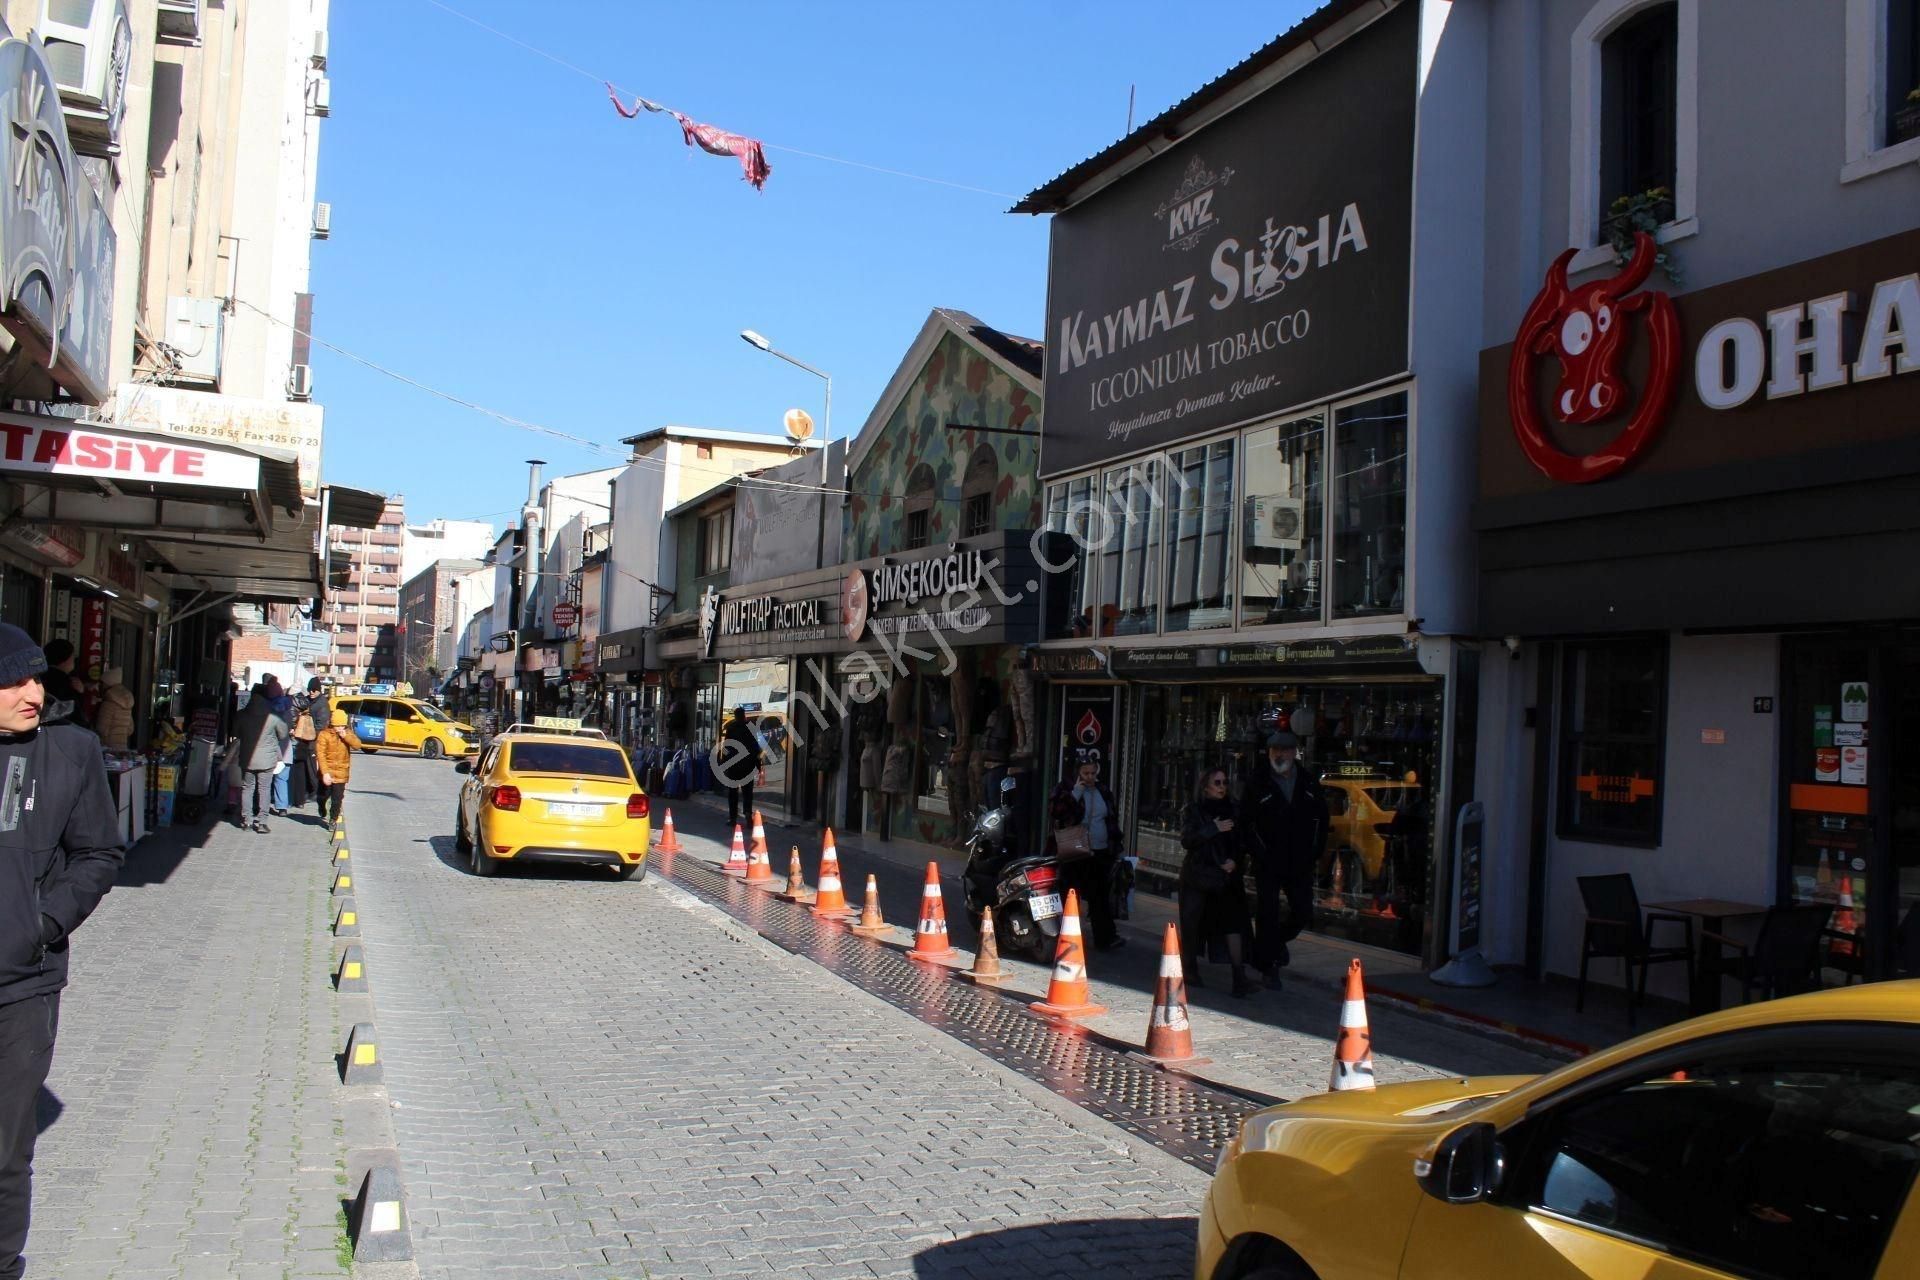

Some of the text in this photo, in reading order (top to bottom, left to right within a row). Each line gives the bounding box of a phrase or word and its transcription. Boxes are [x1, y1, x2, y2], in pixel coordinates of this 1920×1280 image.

[1059, 276, 1196, 374] KAYMAZ
[1089, 309, 1310, 411] ICCONIUM TOBACCO
[1175, 390, 1226, 418] Duman
[211, 428, 224, 437] 29
[244, 431, 287, 443] Fax:425
[290, 436, 303, 445] 67
[306, 437, 319, 446] 23
[872, 542, 981, 612] ŞİMŞEKOĞLU
[721, 596, 820, 635] WOLFTRAP TACTICAL
